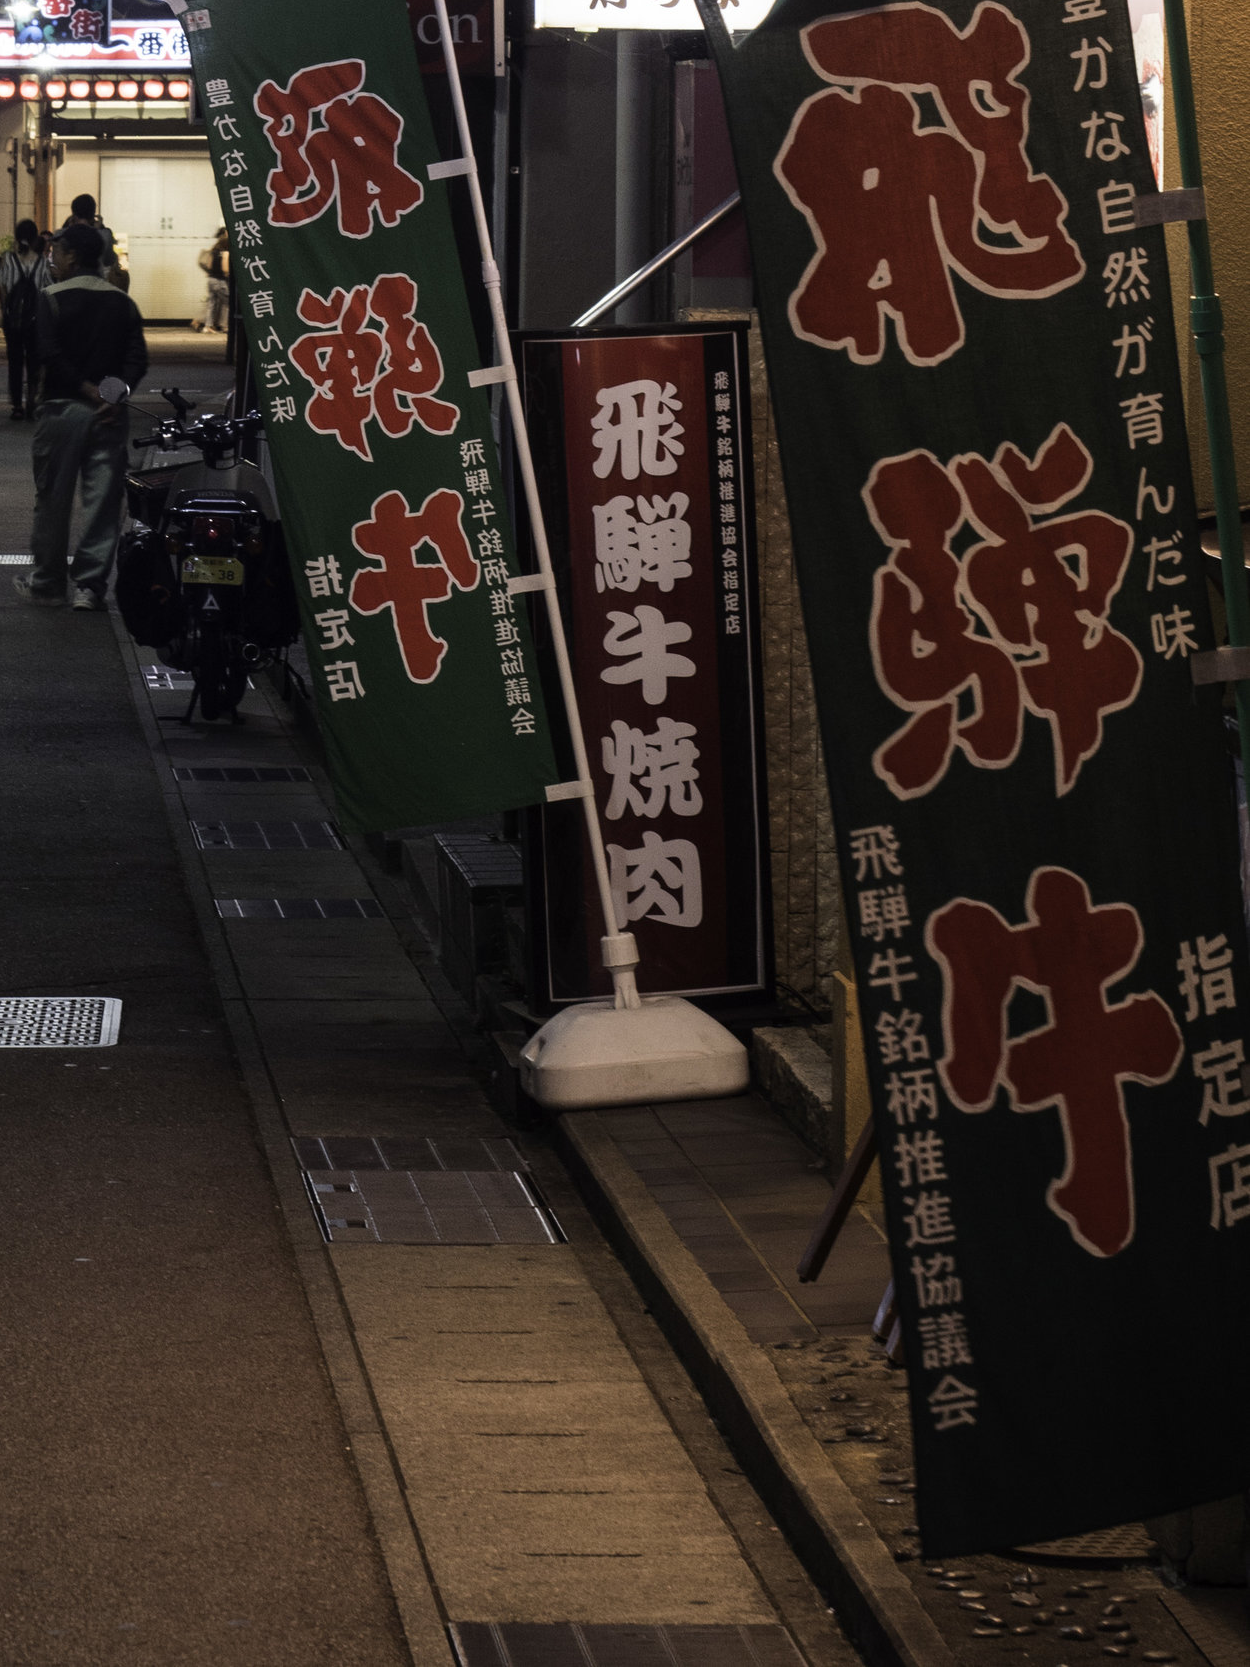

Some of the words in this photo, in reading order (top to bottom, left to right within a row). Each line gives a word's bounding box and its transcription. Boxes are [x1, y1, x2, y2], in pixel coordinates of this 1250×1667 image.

[591, 378, 703, 930] 飛騨牛焼肉
[772, 0, 1184, 1258] 飛騨牛
[850, 824, 979, 1431] 飛騨牛銘柄推進協議会
[1177, 932, 1250, 1233] 指定店
